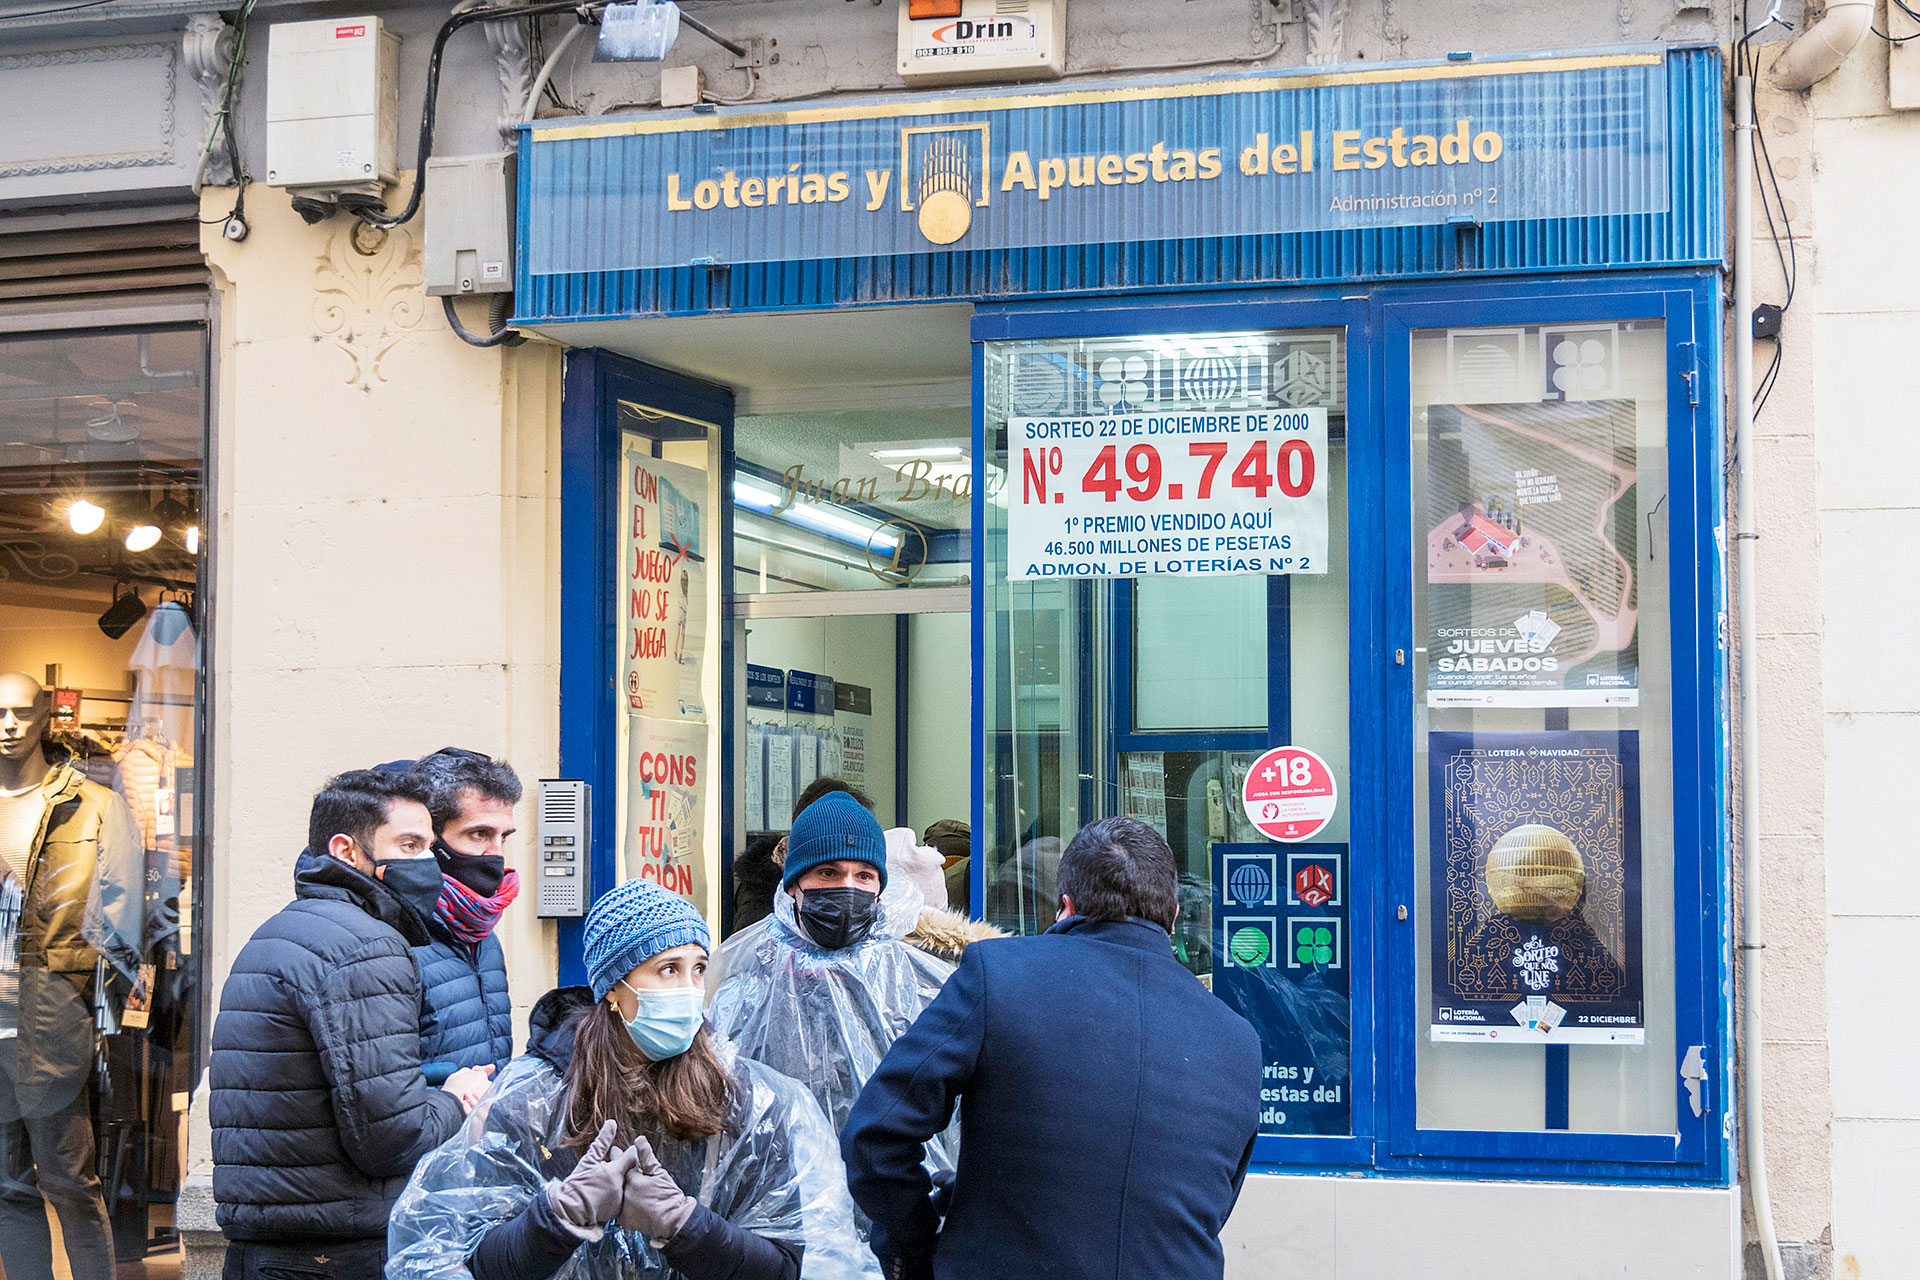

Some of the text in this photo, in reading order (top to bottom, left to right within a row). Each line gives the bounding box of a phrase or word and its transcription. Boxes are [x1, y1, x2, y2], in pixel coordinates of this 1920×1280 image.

[955, 17, 1013, 40] Drin
[917, 46, 974, 57] 902 902 910
[667, 119, 1504, 212] Loterías y Apuestas del Estado
[1328, 187, 1499, 213] Administración nº 2
[1025, 412, 1310, 439] SORTEO 22 DE DICIEMBRE DE 2000
[1081, 439, 1316, 503] 49.740
[634, 465, 658, 504] CON
[771, 463, 880, 514] Juan
[633, 504, 647, 540] EL
[1064, 507, 1273, 534] 1º PREMIO VENDIDO AQUÍ
[1044, 534, 1292, 556] 46.500 MILLONES DE PESETAS
[631, 546, 672, 584] JUEGO
[1025, 556, 1310, 576] ADMON. DE LOTERÍAS Nº 2
[631, 588, 670, 622] NO SE
[630, 627, 667, 660] JUEGA
[1437, 628, 1516, 637] SORTEOS DE
[1447, 639, 1543, 655] JUEVES
[1437, 654, 1559, 673] SÁBADOS
[1488, 747, 1525, 756] LOTERÍA
[1540, 749, 1580, 757] NAVIDAD
[639, 751, 697, 787] CONS
[1261, 756, 1312, 787] +18
[649, 789, 666, 822] TI
[638, 826, 663, 858] TU
[1299, 870, 1308, 888] 1
[1317, 868, 1330, 892] X
[1523, 935, 1544, 951] EL
[1512, 945, 1559, 968] SORTEO
[1524, 957, 1559, 973] QUE NOS
[1578, 1015, 1637, 1024] 22 DICIEMBRE
[1303, 1066, 1314, 1084] y
[1313, 1085, 1341, 1103] del
